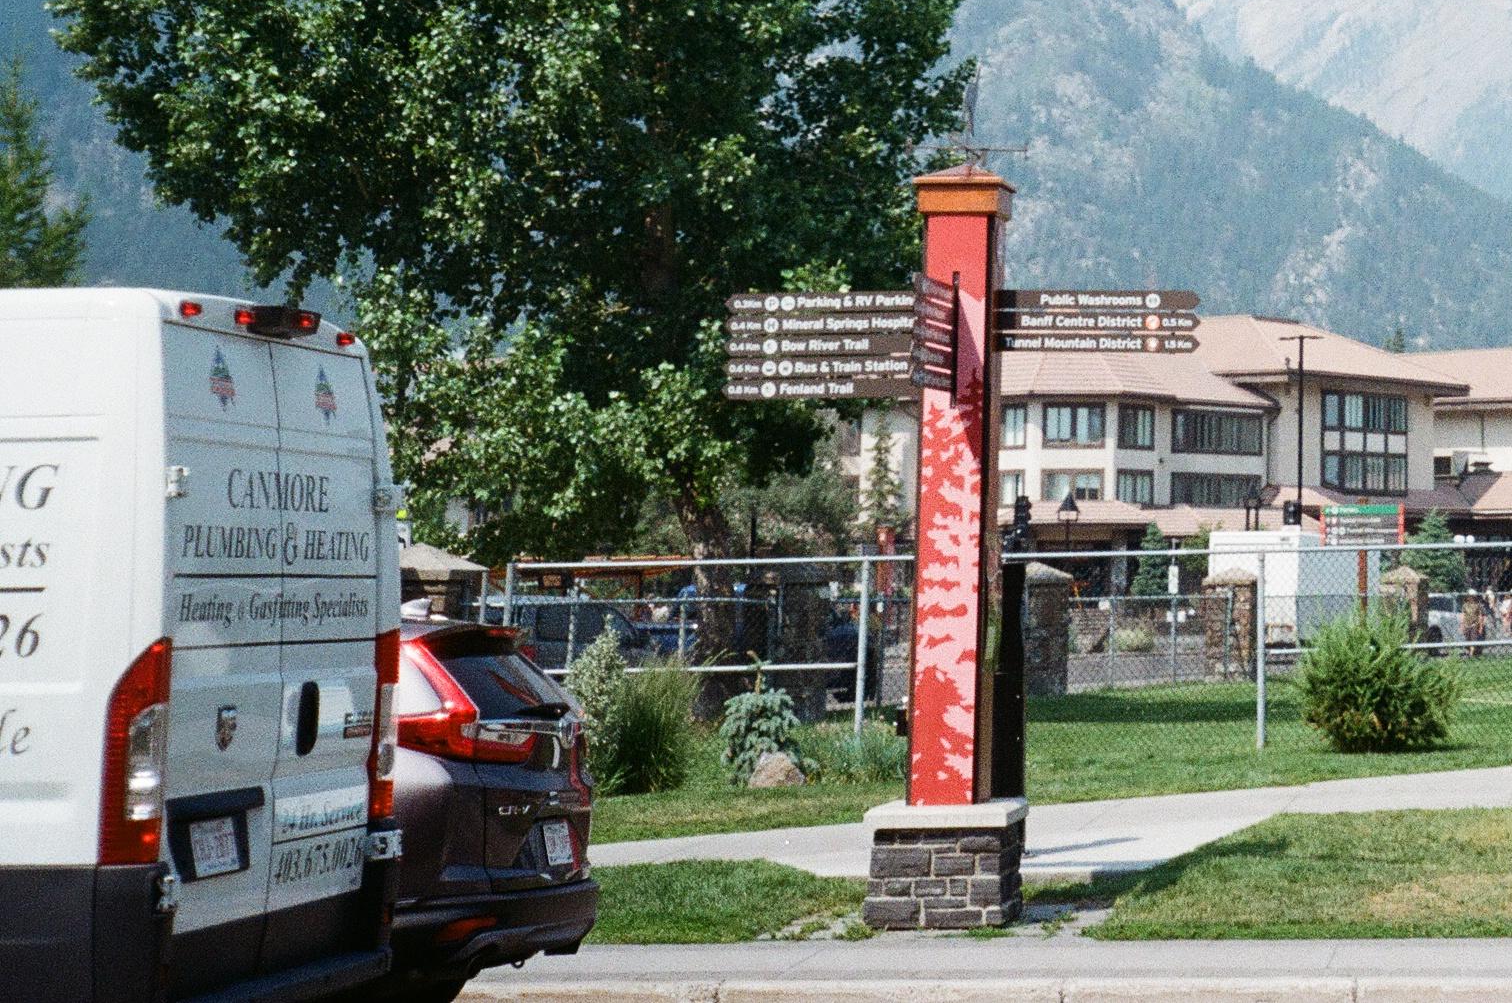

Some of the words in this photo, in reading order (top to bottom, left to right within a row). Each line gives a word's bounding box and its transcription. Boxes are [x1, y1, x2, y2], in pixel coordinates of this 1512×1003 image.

[797, 296, 842, 309] Parking
[843, 296, 853, 307] &
[855, 295, 874, 306] RV
[875, 294, 916, 306] Parkin
[1040, 294, 1075, 306] Public
[1078, 294, 1142, 306] Washrooms
[746, 322, 762, 330] Km
[782, 318, 824, 330] Mineral
[826, 317, 869, 331] Springs
[872, 316, 918, 330] Hospita
[1021, 315, 1053, 326] Banff
[1055, 315, 1095, 326] Centre
[1097, 315, 1142, 326] District
[1162, 317, 1177, 327] 0.5
[1178, 317, 1193, 327] Km
[745, 342, 760, 351] Km
[781, 340, 807, 351] Bow
[808, 339, 841, 351] River
[842, 338, 869, 350] Trail
[1005, 337, 1042, 348] Tunnel
[1044, 337, 1096, 348] Mountain
[1099, 336, 1142, 348] District
[1164, 339, 1177, 349] 1.5
[1177, 339, 1192, 349] Km
[744, 364, 759, 373] Km
[794, 361, 818, 373] Bus
[820, 361, 830, 373] &
[832, 361, 862, 372] Train
[864, 360, 908, 372] Station
[743, 385, 759, 394] Km
[779, 383, 825, 395] Fenland
[827, 382, 854, 394] Trail
[228, 467, 329, 513] CANMORE
[182, 523, 278, 561] PLUMBING
[283, 521, 298, 566] &
[303, 529, 370, 563] HEATING
[179, 593, 235, 629] Heating
[312, 591, 369, 626] Specialists
